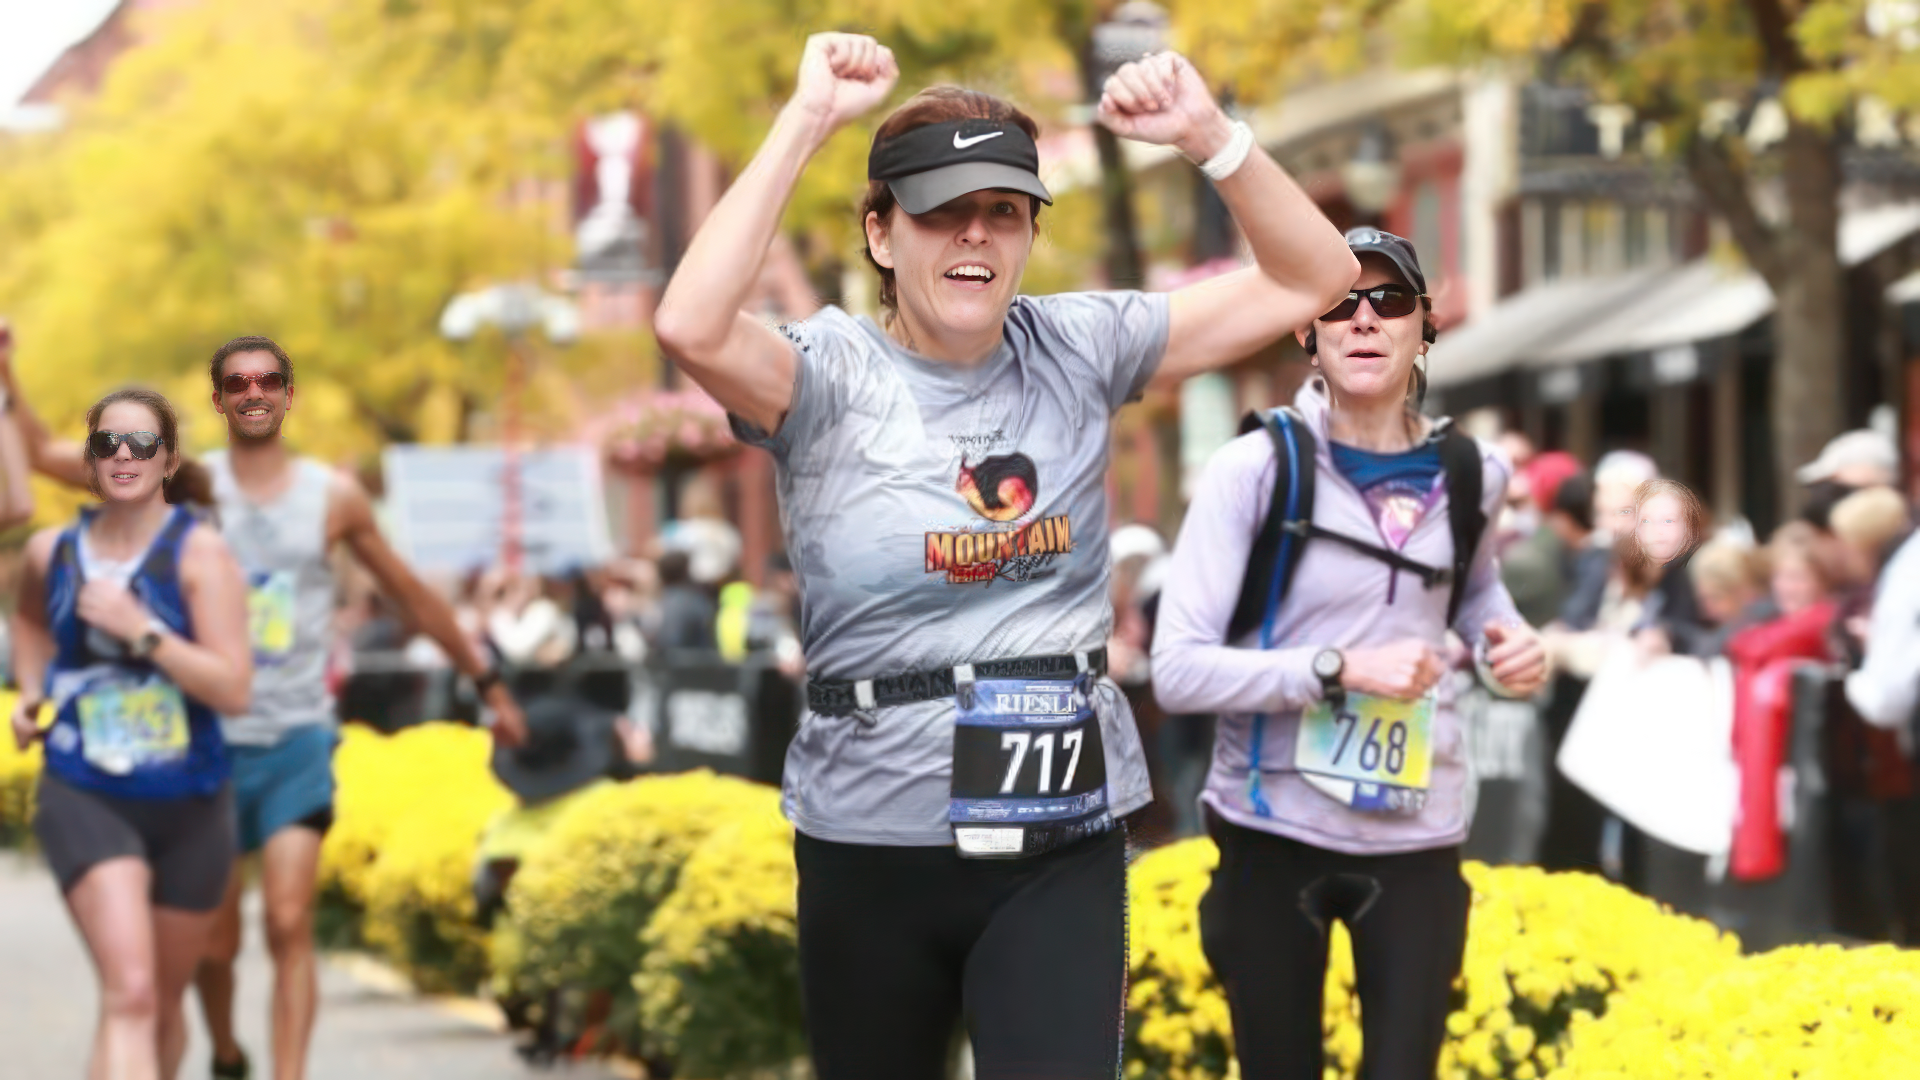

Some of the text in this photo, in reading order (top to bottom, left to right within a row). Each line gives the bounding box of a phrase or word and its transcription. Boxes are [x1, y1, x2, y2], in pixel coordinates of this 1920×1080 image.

[925, 515, 1071, 573] MOUNTAIN
[998, 729, 1085, 794] 717
[1332, 713, 1407, 775] 768
